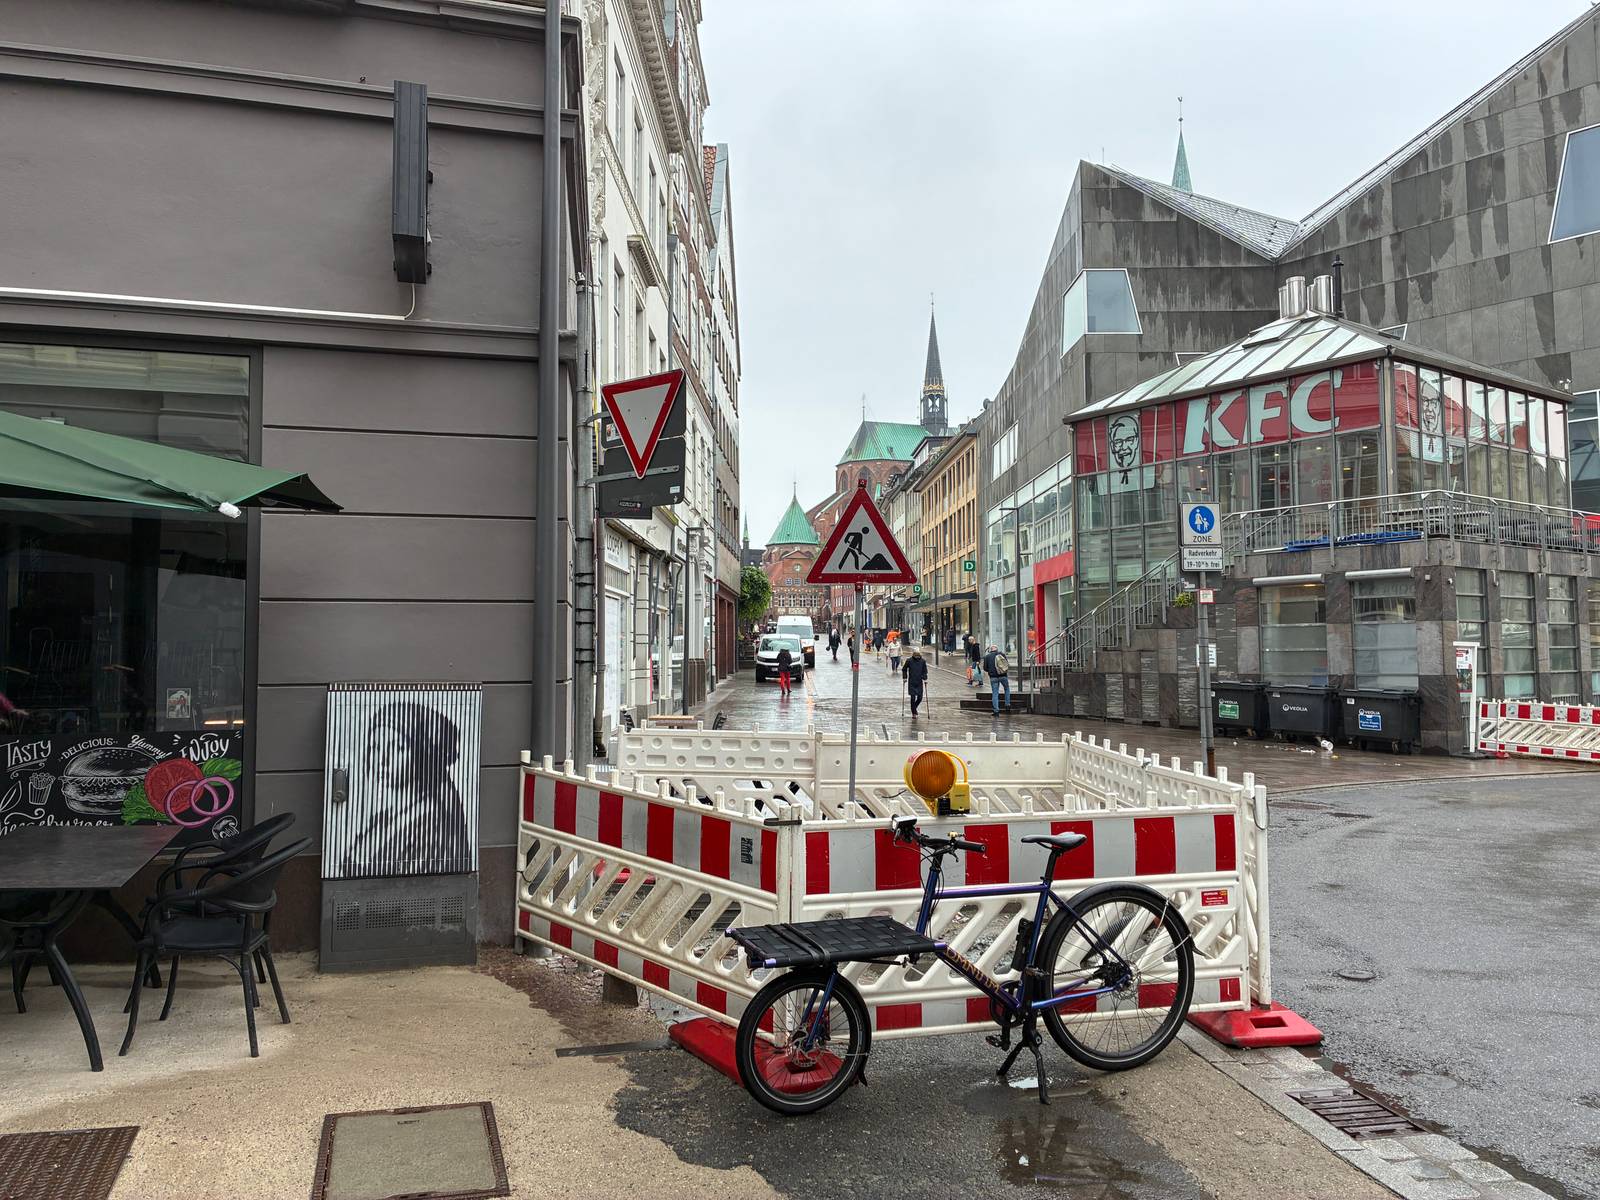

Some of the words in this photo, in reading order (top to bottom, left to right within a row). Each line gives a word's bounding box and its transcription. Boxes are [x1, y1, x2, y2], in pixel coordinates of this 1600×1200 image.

[1183, 369, 1343, 454] KFC
[1192, 535, 1212, 543] ZONE
[1188, 549, 1217, 557] Radverkehr
[1210, 560, 1220, 568] frei
[0, 739, 51, 768] TASTY
[62, 737, 114, 759] DELICIOUS
[127, 734, 172, 760] Yummy!
[179, 733, 230, 763] ENJOY
